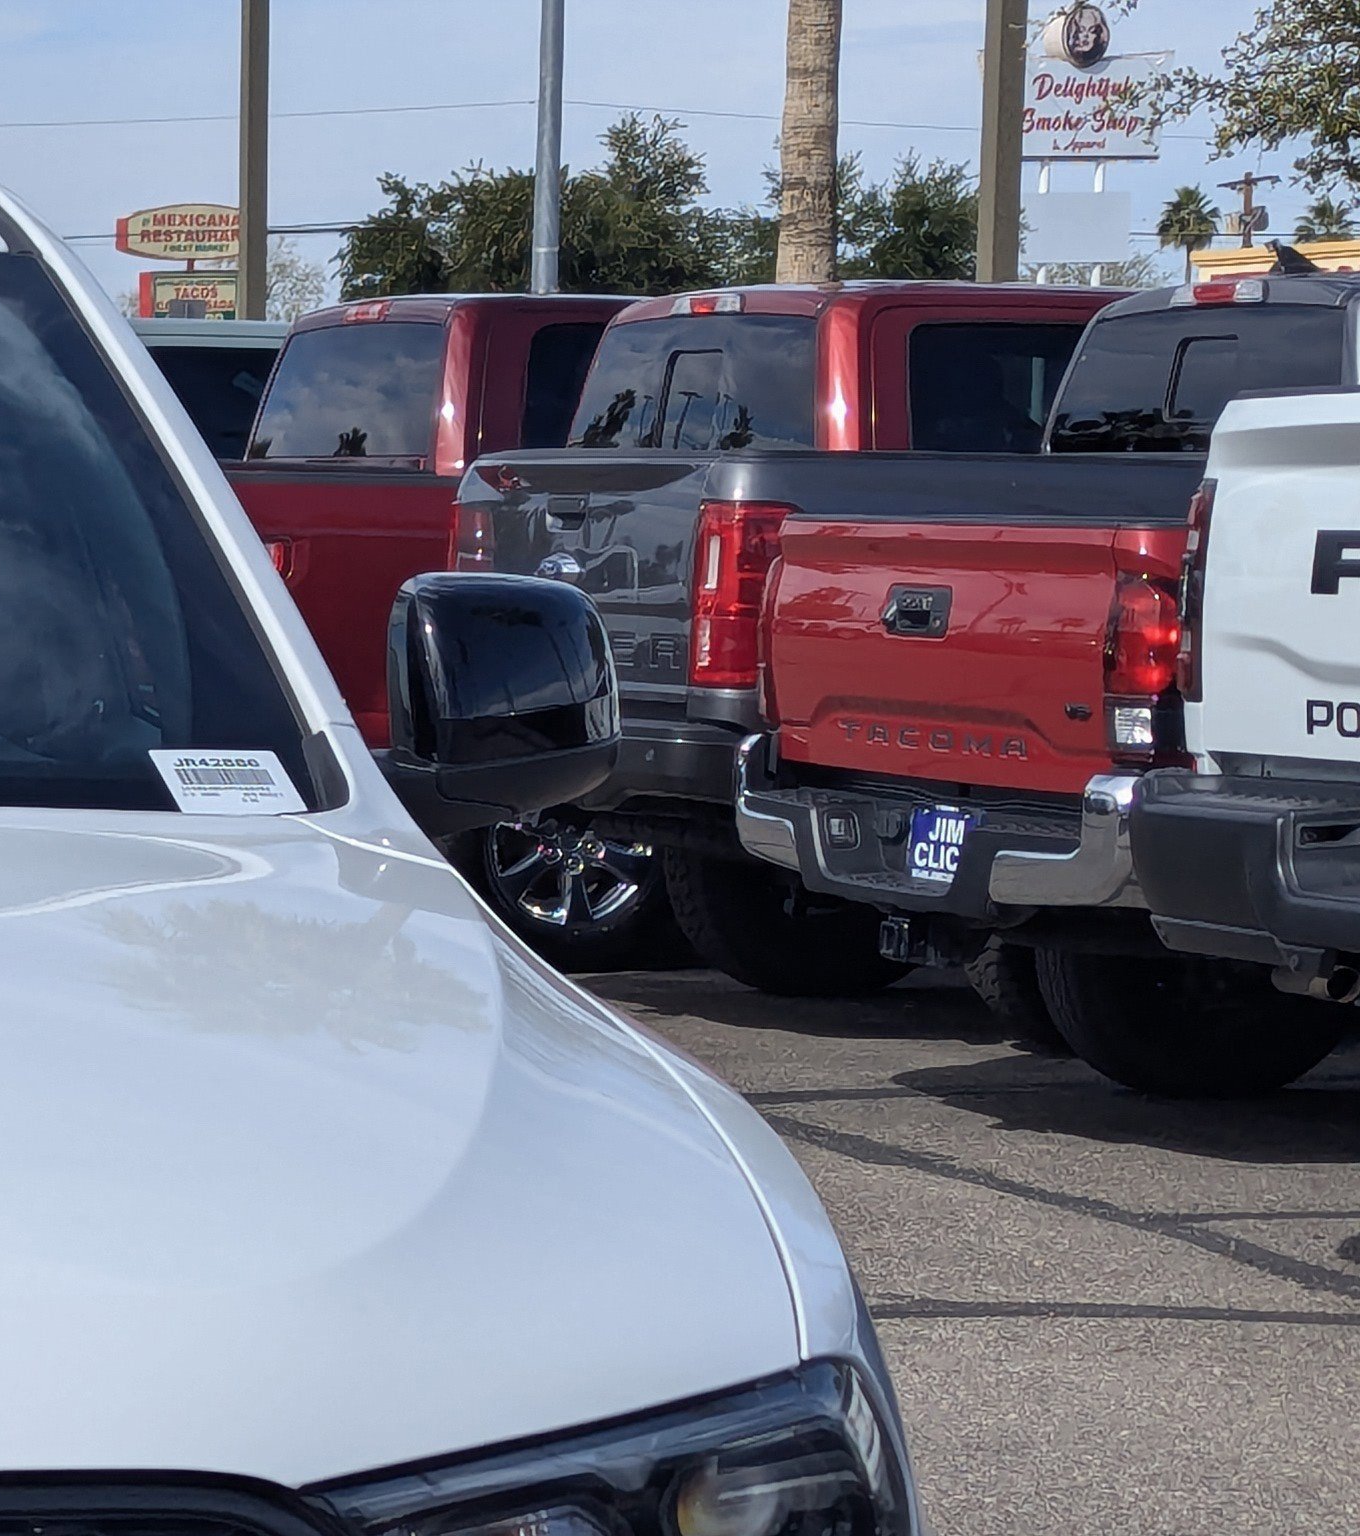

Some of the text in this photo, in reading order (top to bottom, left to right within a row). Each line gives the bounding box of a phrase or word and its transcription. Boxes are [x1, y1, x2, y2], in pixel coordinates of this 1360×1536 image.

[1022, 107, 1084, 134] Smoke
[140, 229, 240, 243] RESTAURAN
[837, 718, 1029, 762] TACOMA
[928, 816, 966, 846] JIM
